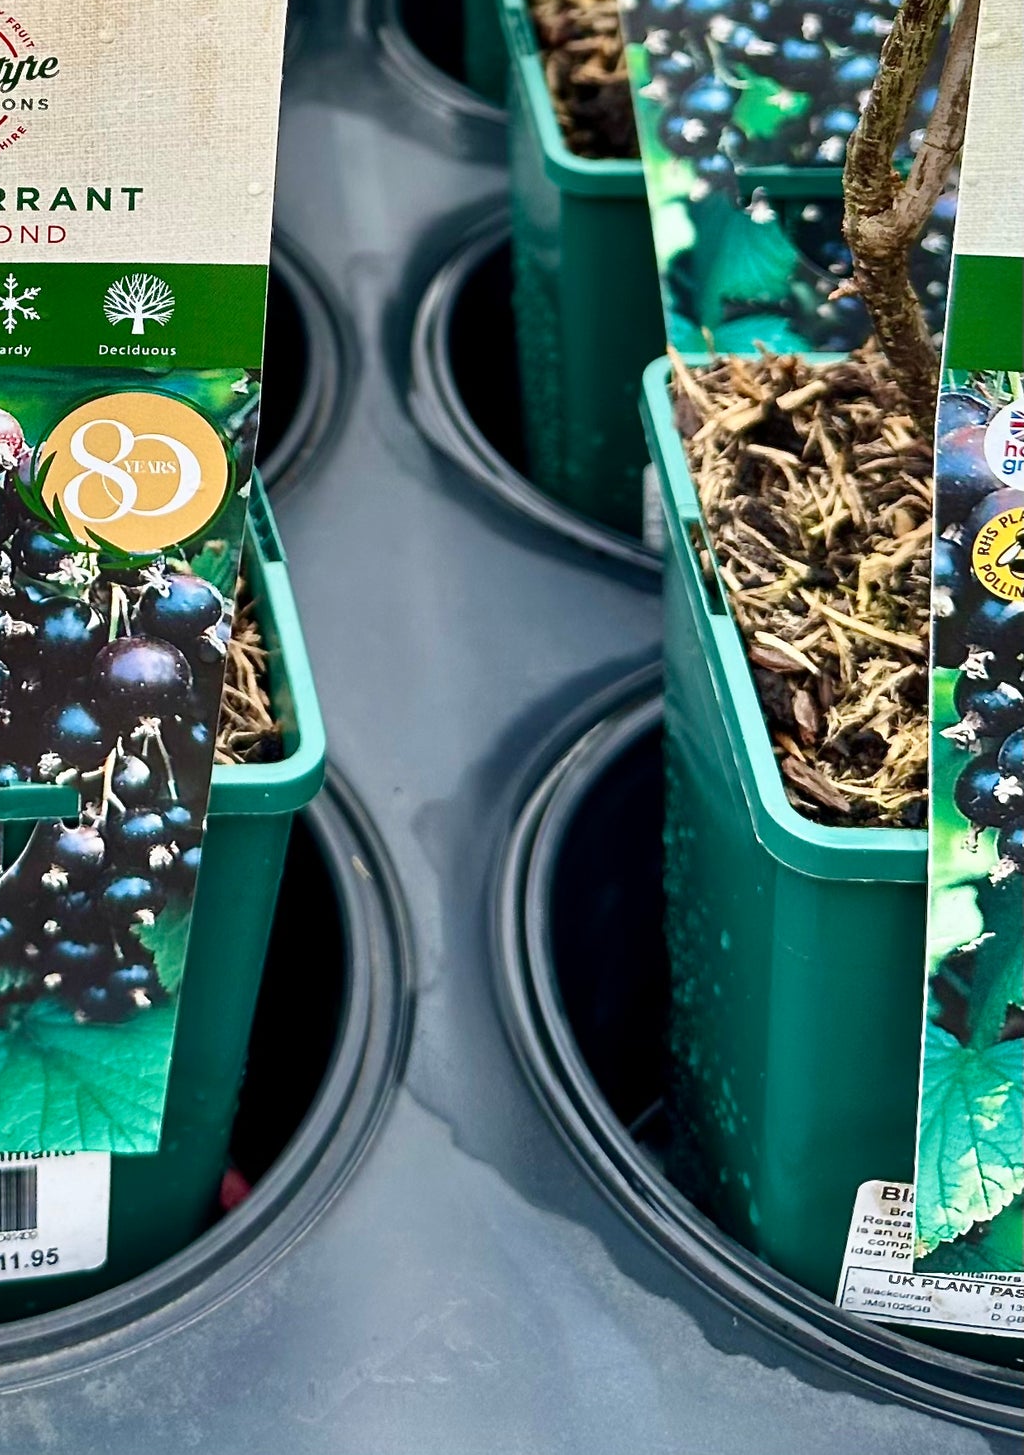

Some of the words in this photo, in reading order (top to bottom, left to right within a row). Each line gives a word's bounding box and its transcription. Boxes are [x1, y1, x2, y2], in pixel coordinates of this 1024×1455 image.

[6, 17, 35, 49] FRUIT
[98, 345, 177, 356] Deciduous
[63, 418, 202, 524] 80
[123, 460, 177, 474] YEARS
[977, 528, 998, 556] RHS
[857, 1226, 869, 1234] is
[874, 1229, 893, 1237] an
[850, 1246, 887, 1257] ideal
[891, 1250, 911, 1260] for
[887, 1274, 916, 1288] UK
[921, 1279, 985, 1294] PLANT
[862, 1287, 933, 1302] Blackcurrant
[991, 1313, 1001, 1321] D
